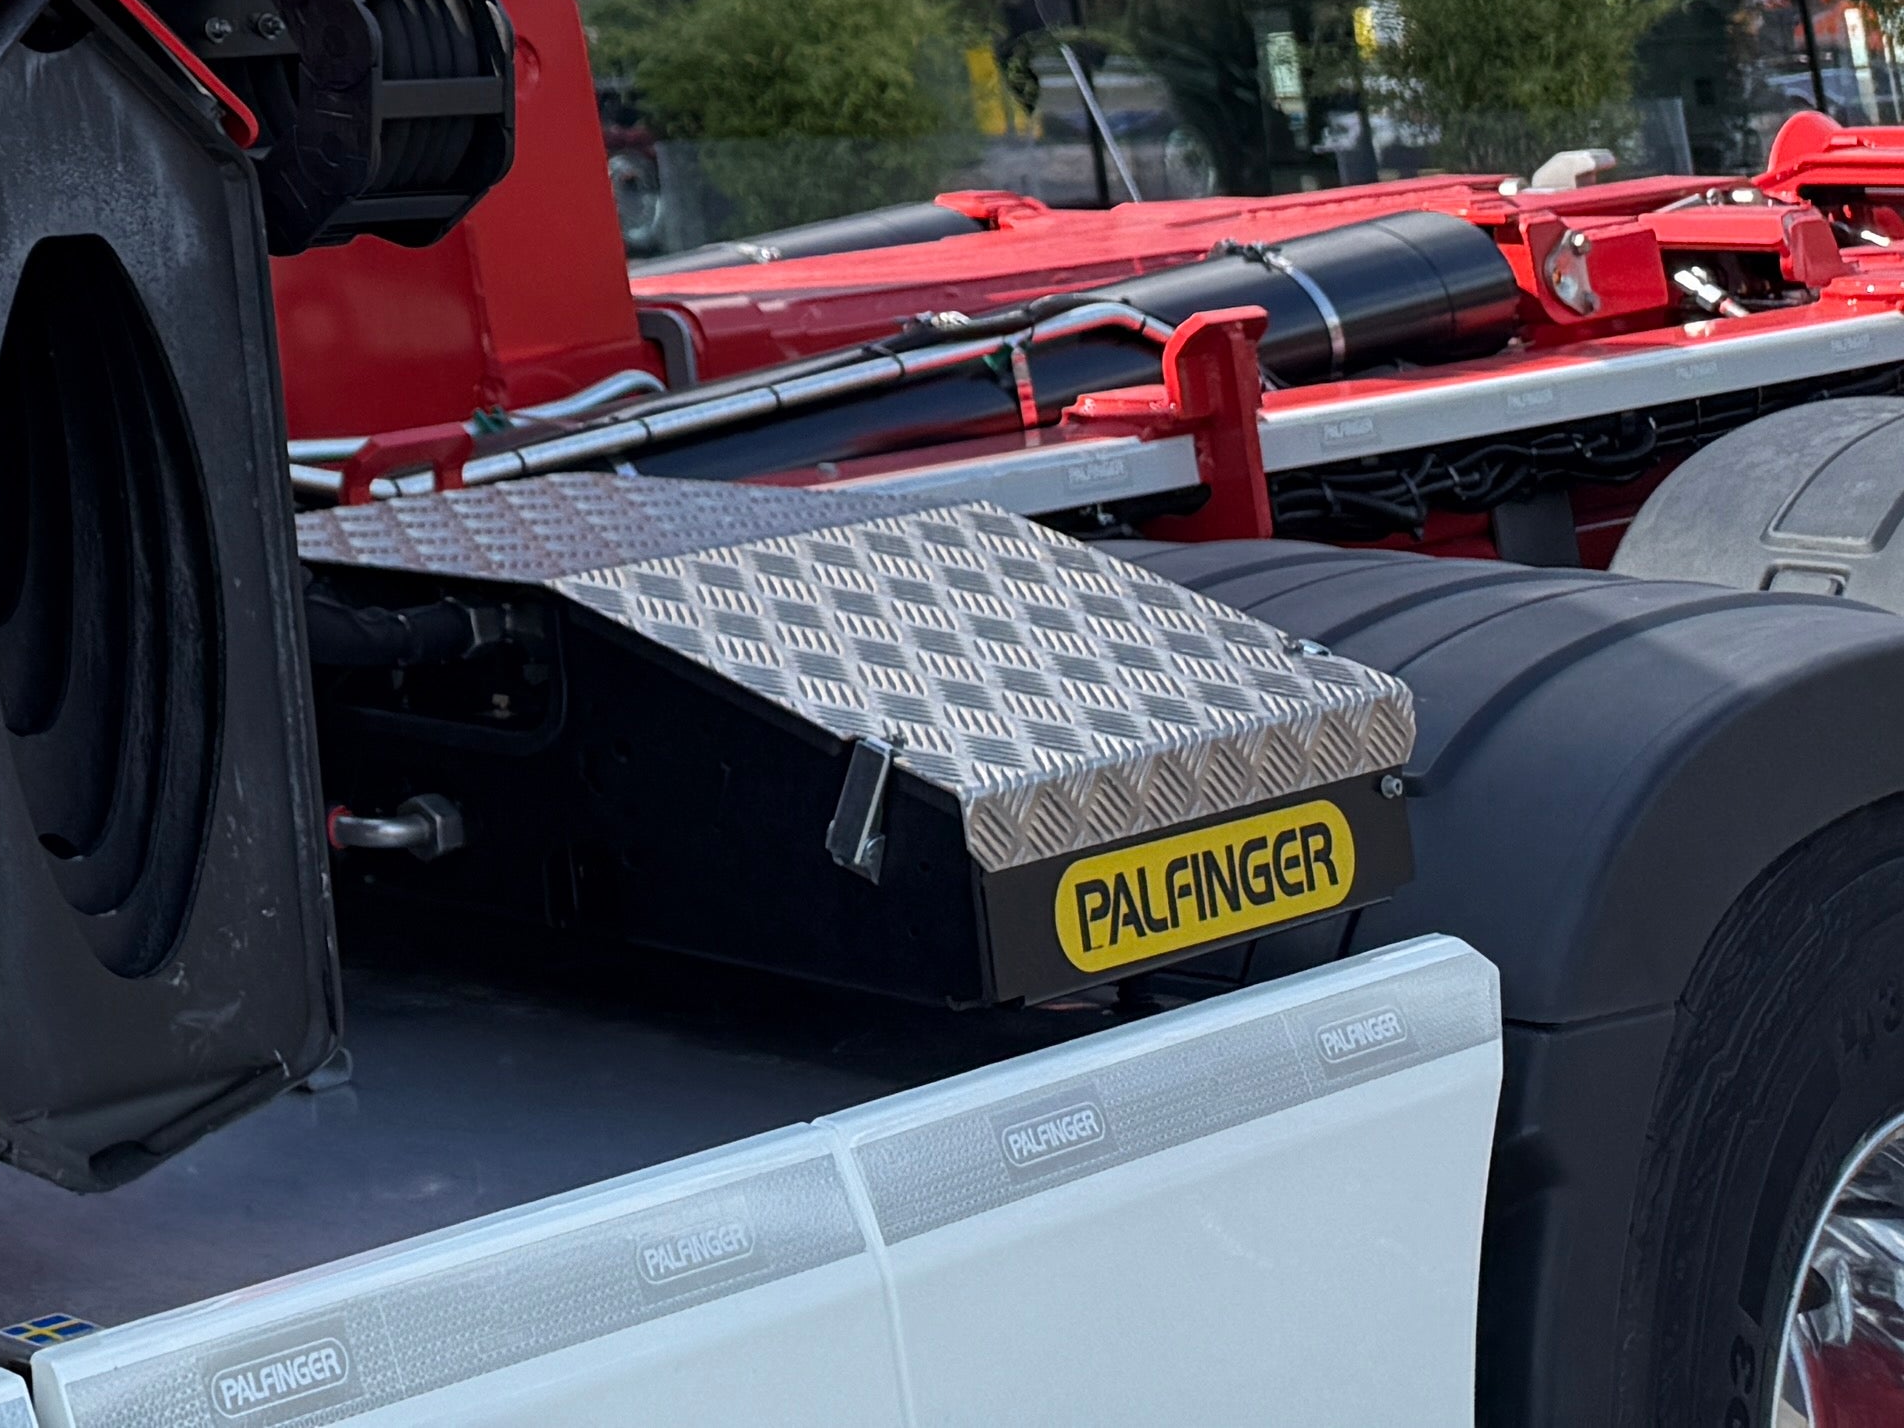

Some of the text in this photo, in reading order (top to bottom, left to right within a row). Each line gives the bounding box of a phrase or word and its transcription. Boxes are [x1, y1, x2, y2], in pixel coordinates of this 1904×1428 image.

[1075, 821, 1339, 953] PALFINGER
[1320, 1012, 1402, 1056] PALFINGER
[1007, 1109, 1100, 1160] PALFINGER
[643, 1222, 749, 1278] PALFINGER
[219, 1346, 342, 1410] PALFINGER
